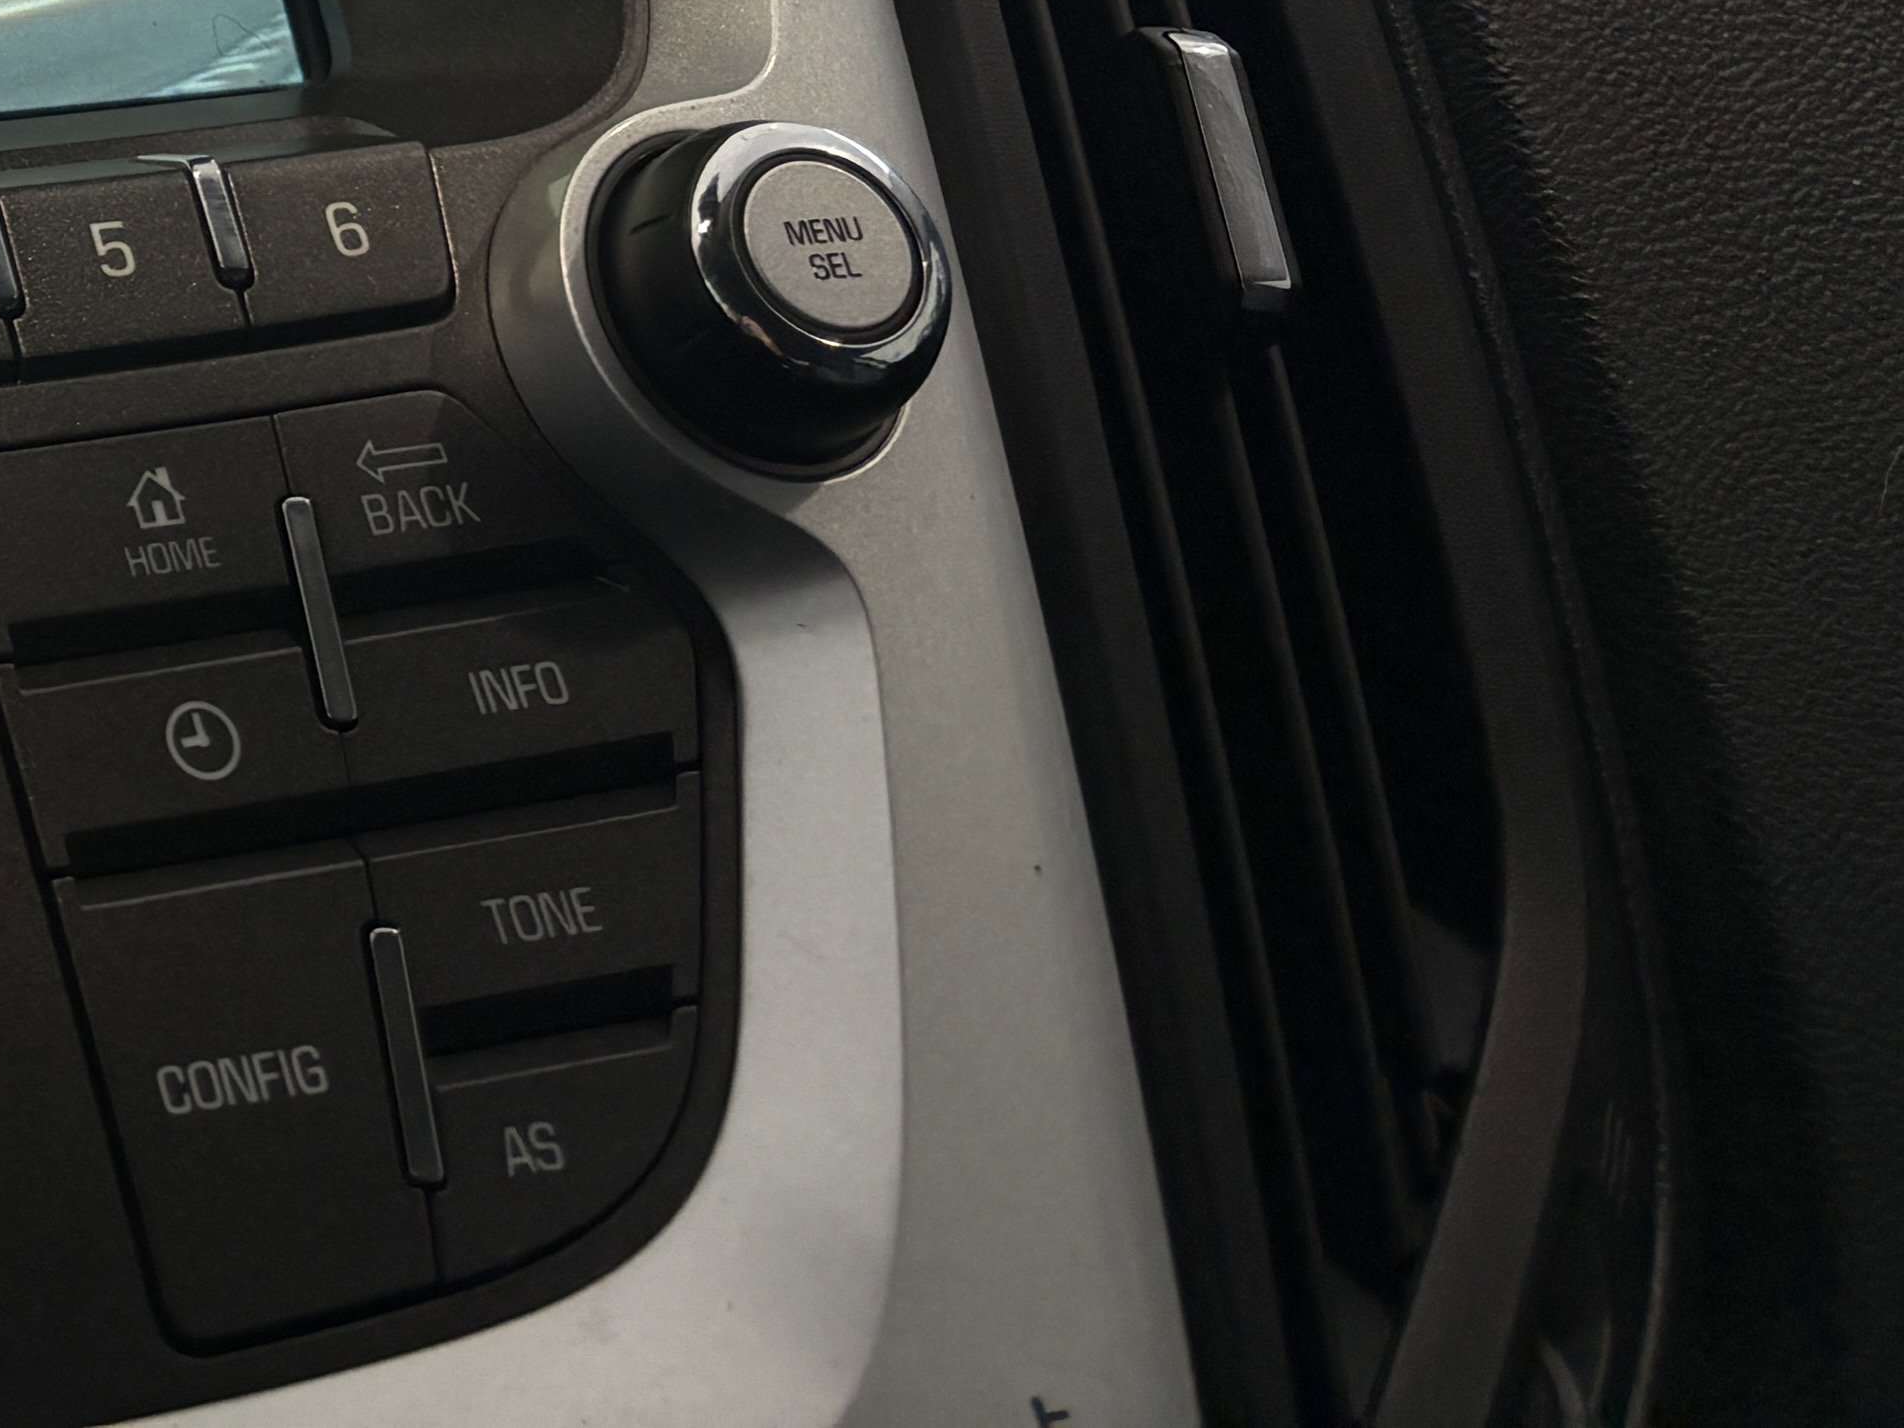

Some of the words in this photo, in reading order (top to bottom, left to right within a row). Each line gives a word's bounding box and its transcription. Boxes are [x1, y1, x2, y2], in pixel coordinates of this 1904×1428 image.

[89, 220, 136, 277] 5
[325, 201, 370, 257] 6
[783, 216, 864, 247] MENU
[808, 251, 863, 281] SEL
[360, 483, 481, 536] BACK
[125, 537, 221, 578] HOME
[468, 660, 570, 715] INFO
[481, 886, 603, 946] TONE
[156, 1045, 330, 1115] CONFIG
[504, 1121, 566, 1177] AS
